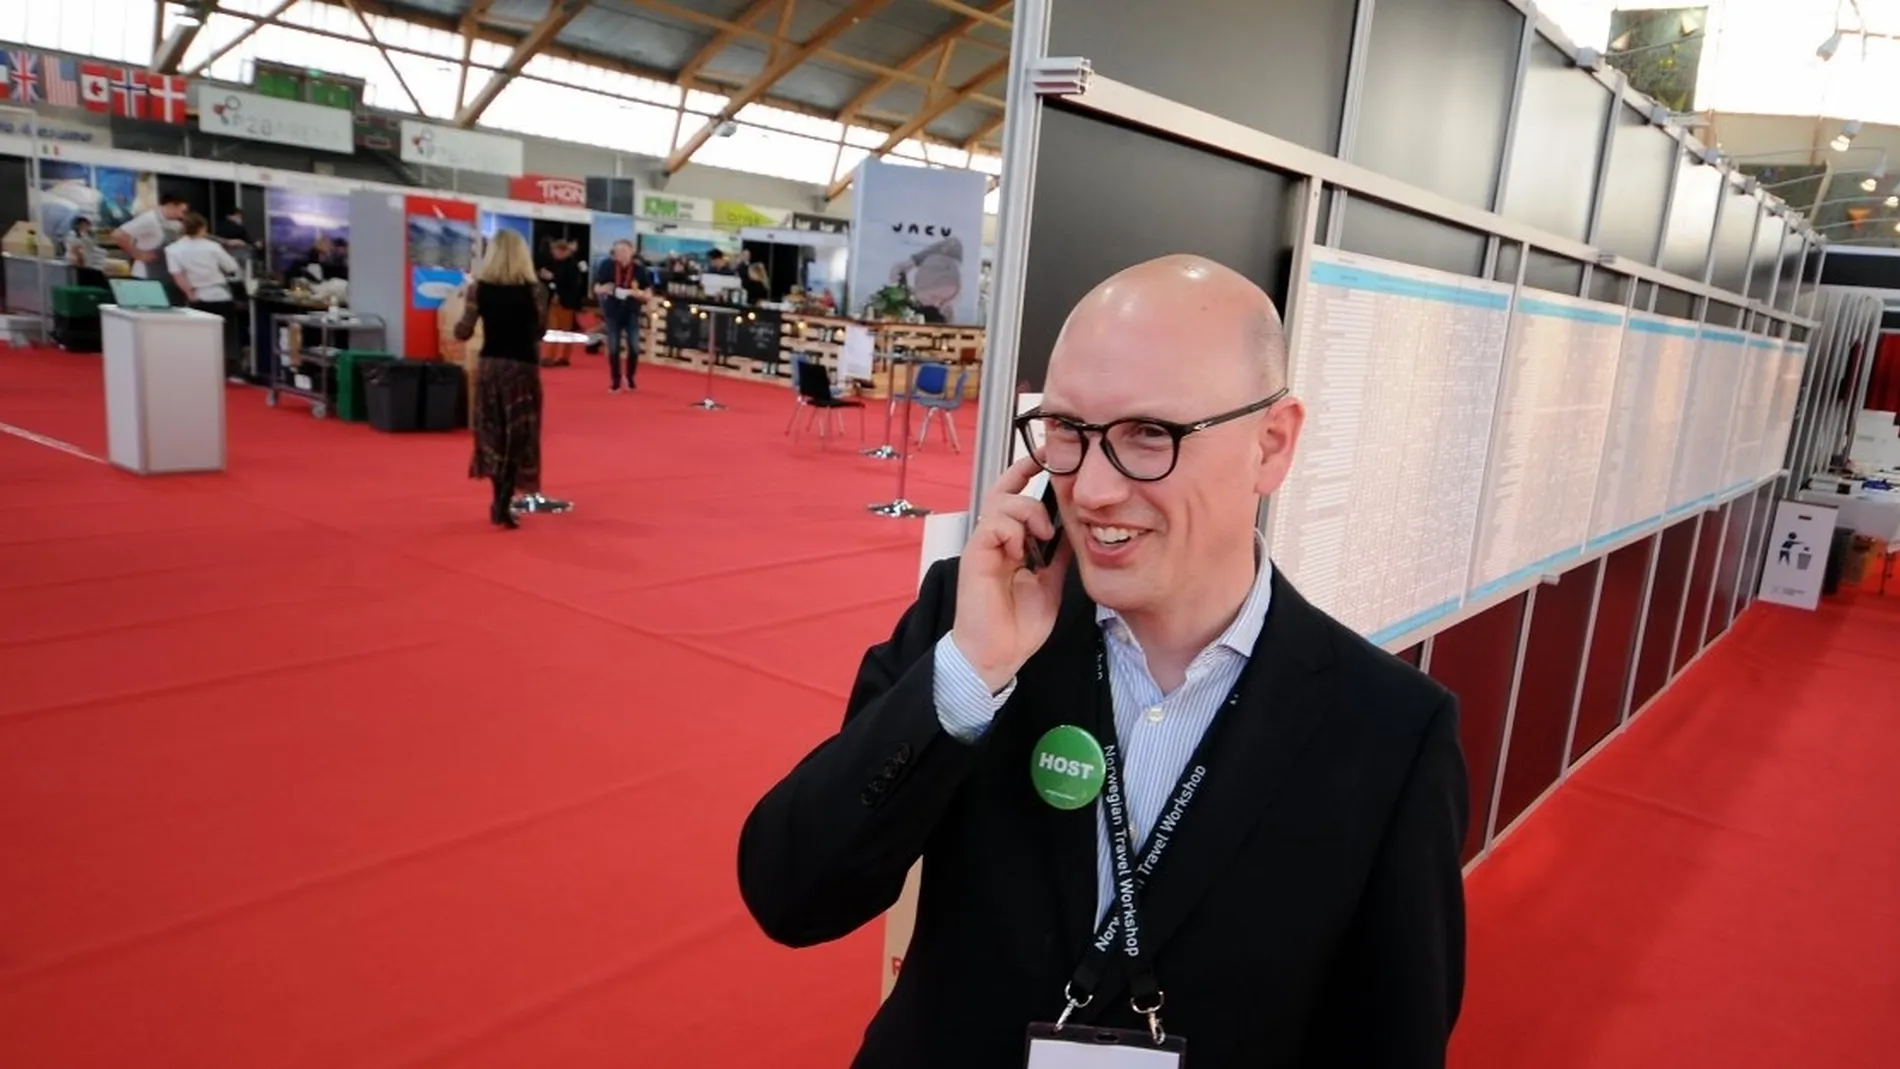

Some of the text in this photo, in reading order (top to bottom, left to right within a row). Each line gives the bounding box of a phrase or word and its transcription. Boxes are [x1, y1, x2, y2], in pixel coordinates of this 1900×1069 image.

[1039, 752, 1094, 779] HOST
[1136, 764, 1206, 876] Travel Workshop
[1104, 744, 1139, 957] Norwegian Travel Workshop
